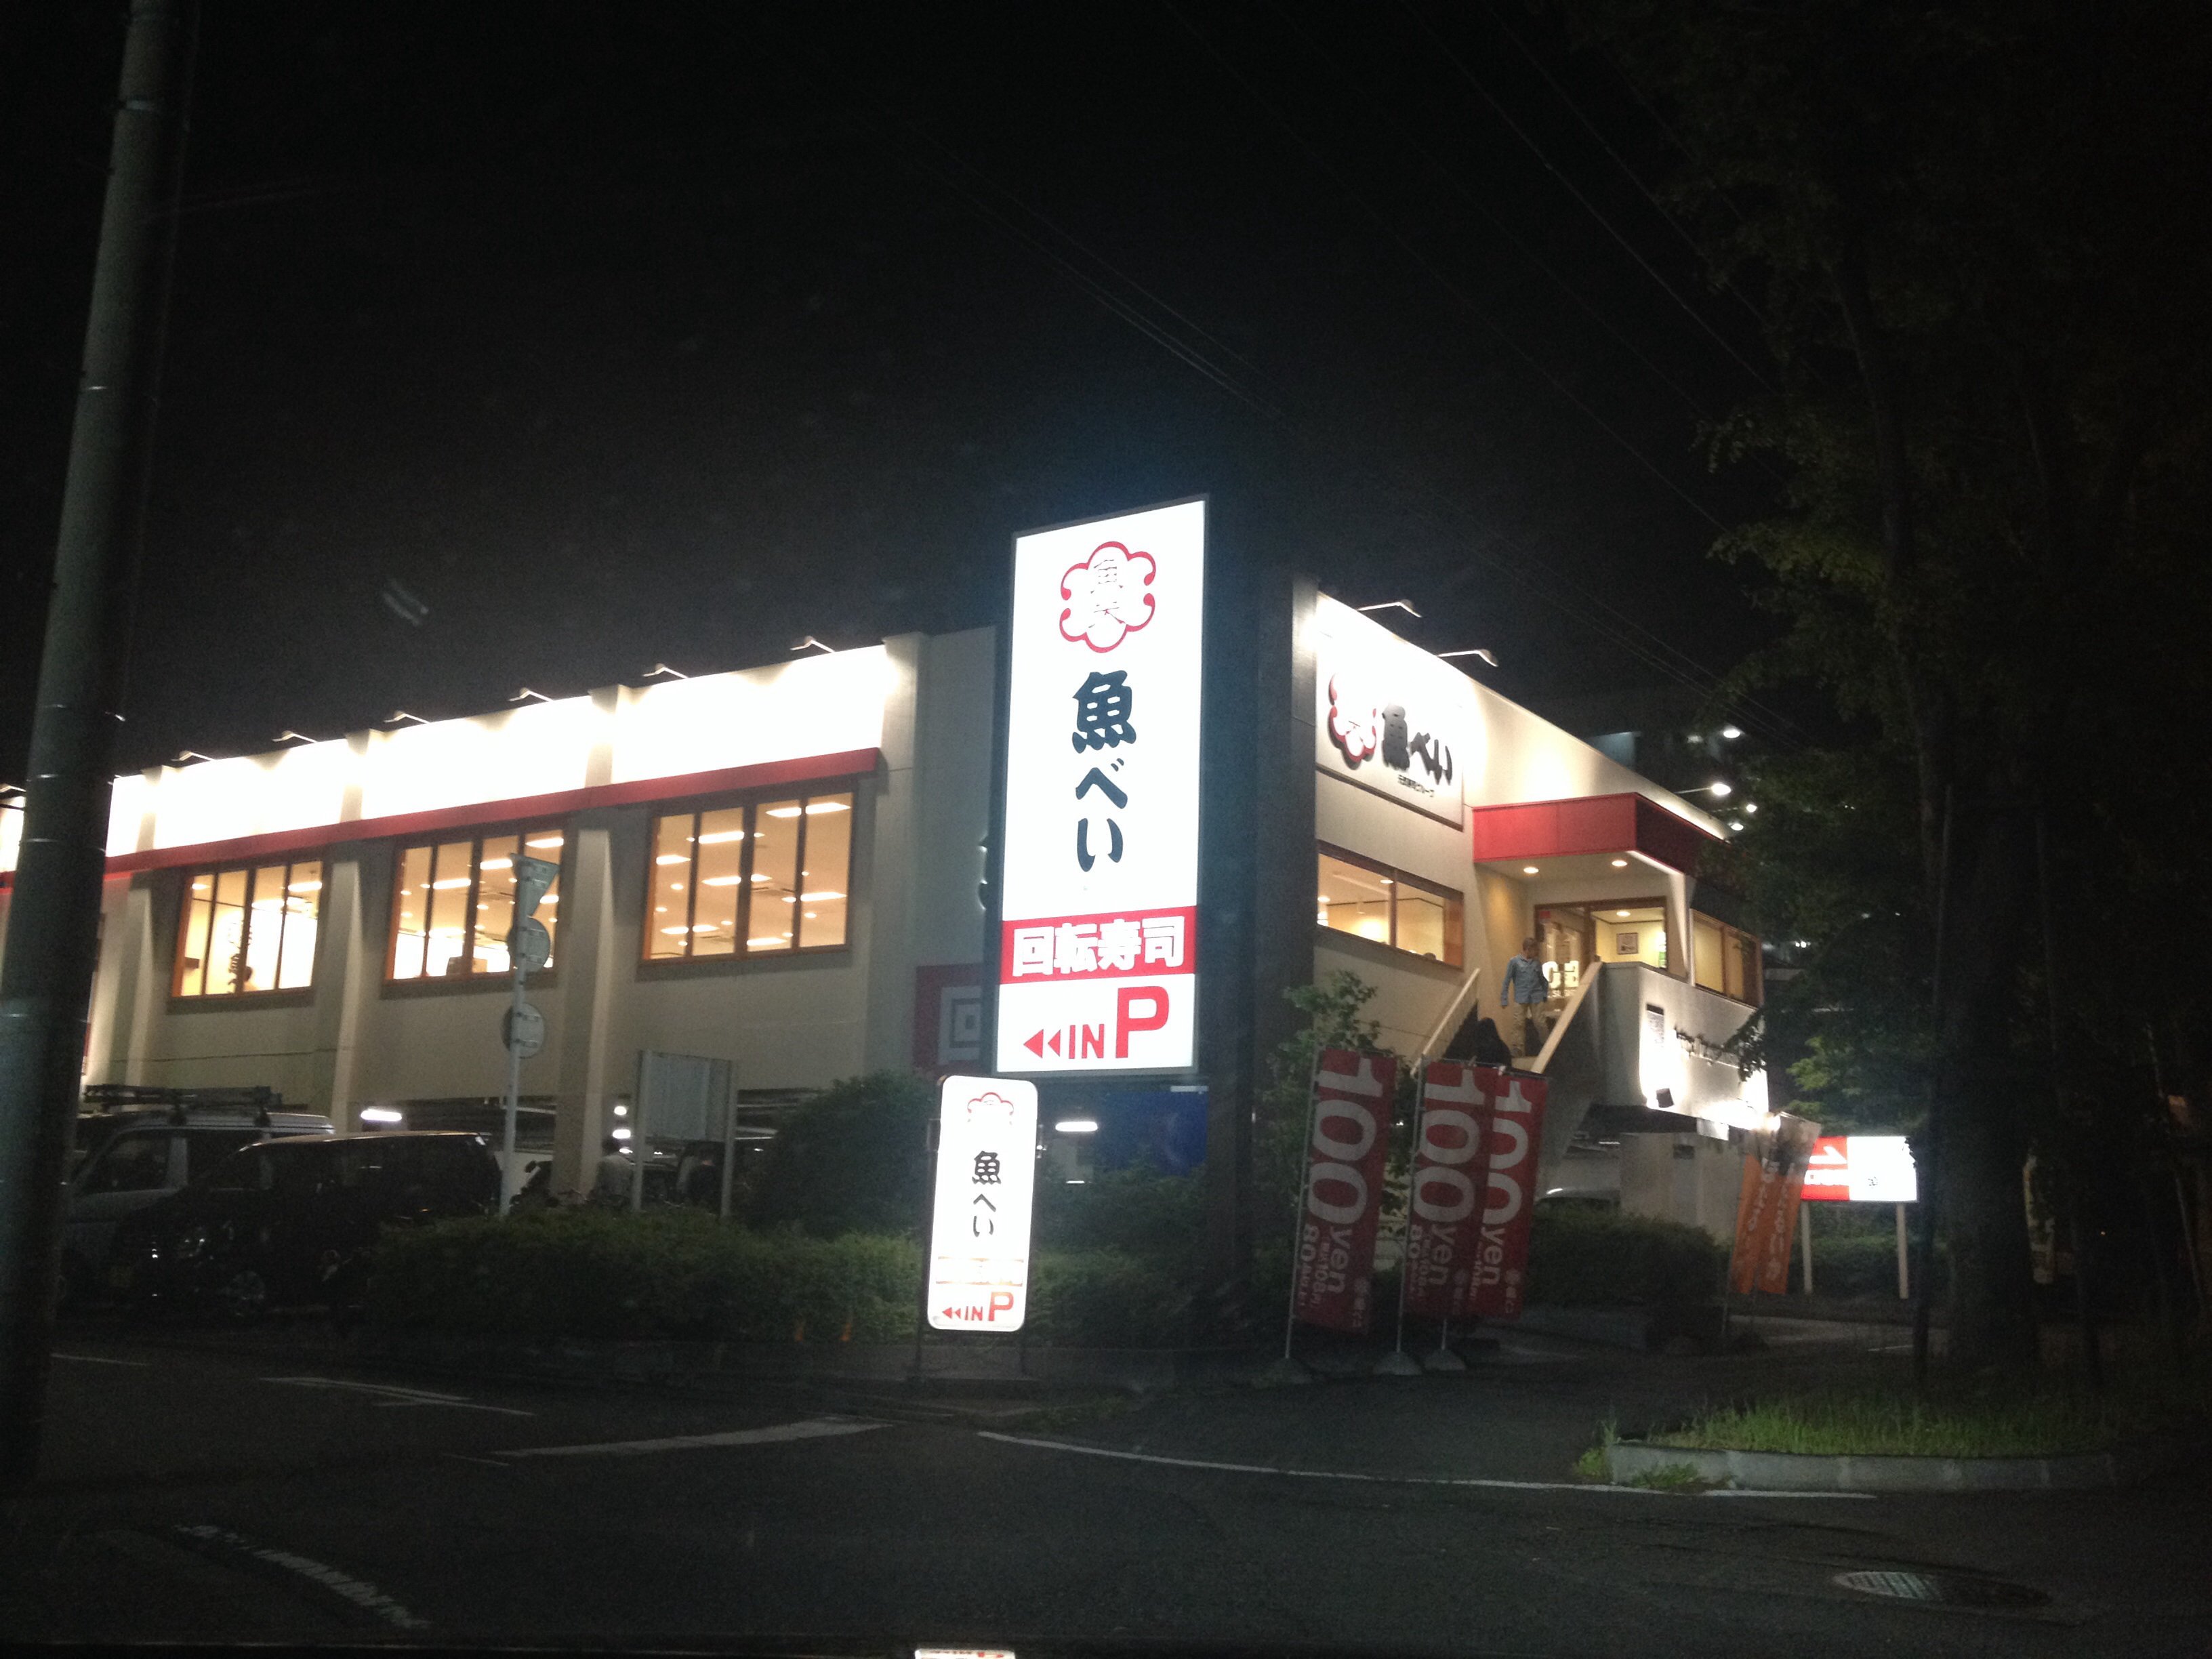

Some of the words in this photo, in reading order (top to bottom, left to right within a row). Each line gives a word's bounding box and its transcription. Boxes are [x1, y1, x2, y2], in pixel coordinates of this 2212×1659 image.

[1072, 670, 1136, 872] 魚べい
[1012, 916, 1185, 977] 回転寿司
[1068, 1023, 1105, 1059] IN
[1115, 985, 1169, 1059] P
[1307, 1057, 1383, 1225] 100
[1414, 1069, 1486, 1223] 100
[1328, 1225, 1352, 1294] yen
[1429, 1223, 1457, 1286] yen
[1481, 1226, 1506, 1286] yen
[964, 1305, 983, 1321] IN
[987, 1291, 1014, 1322] P
